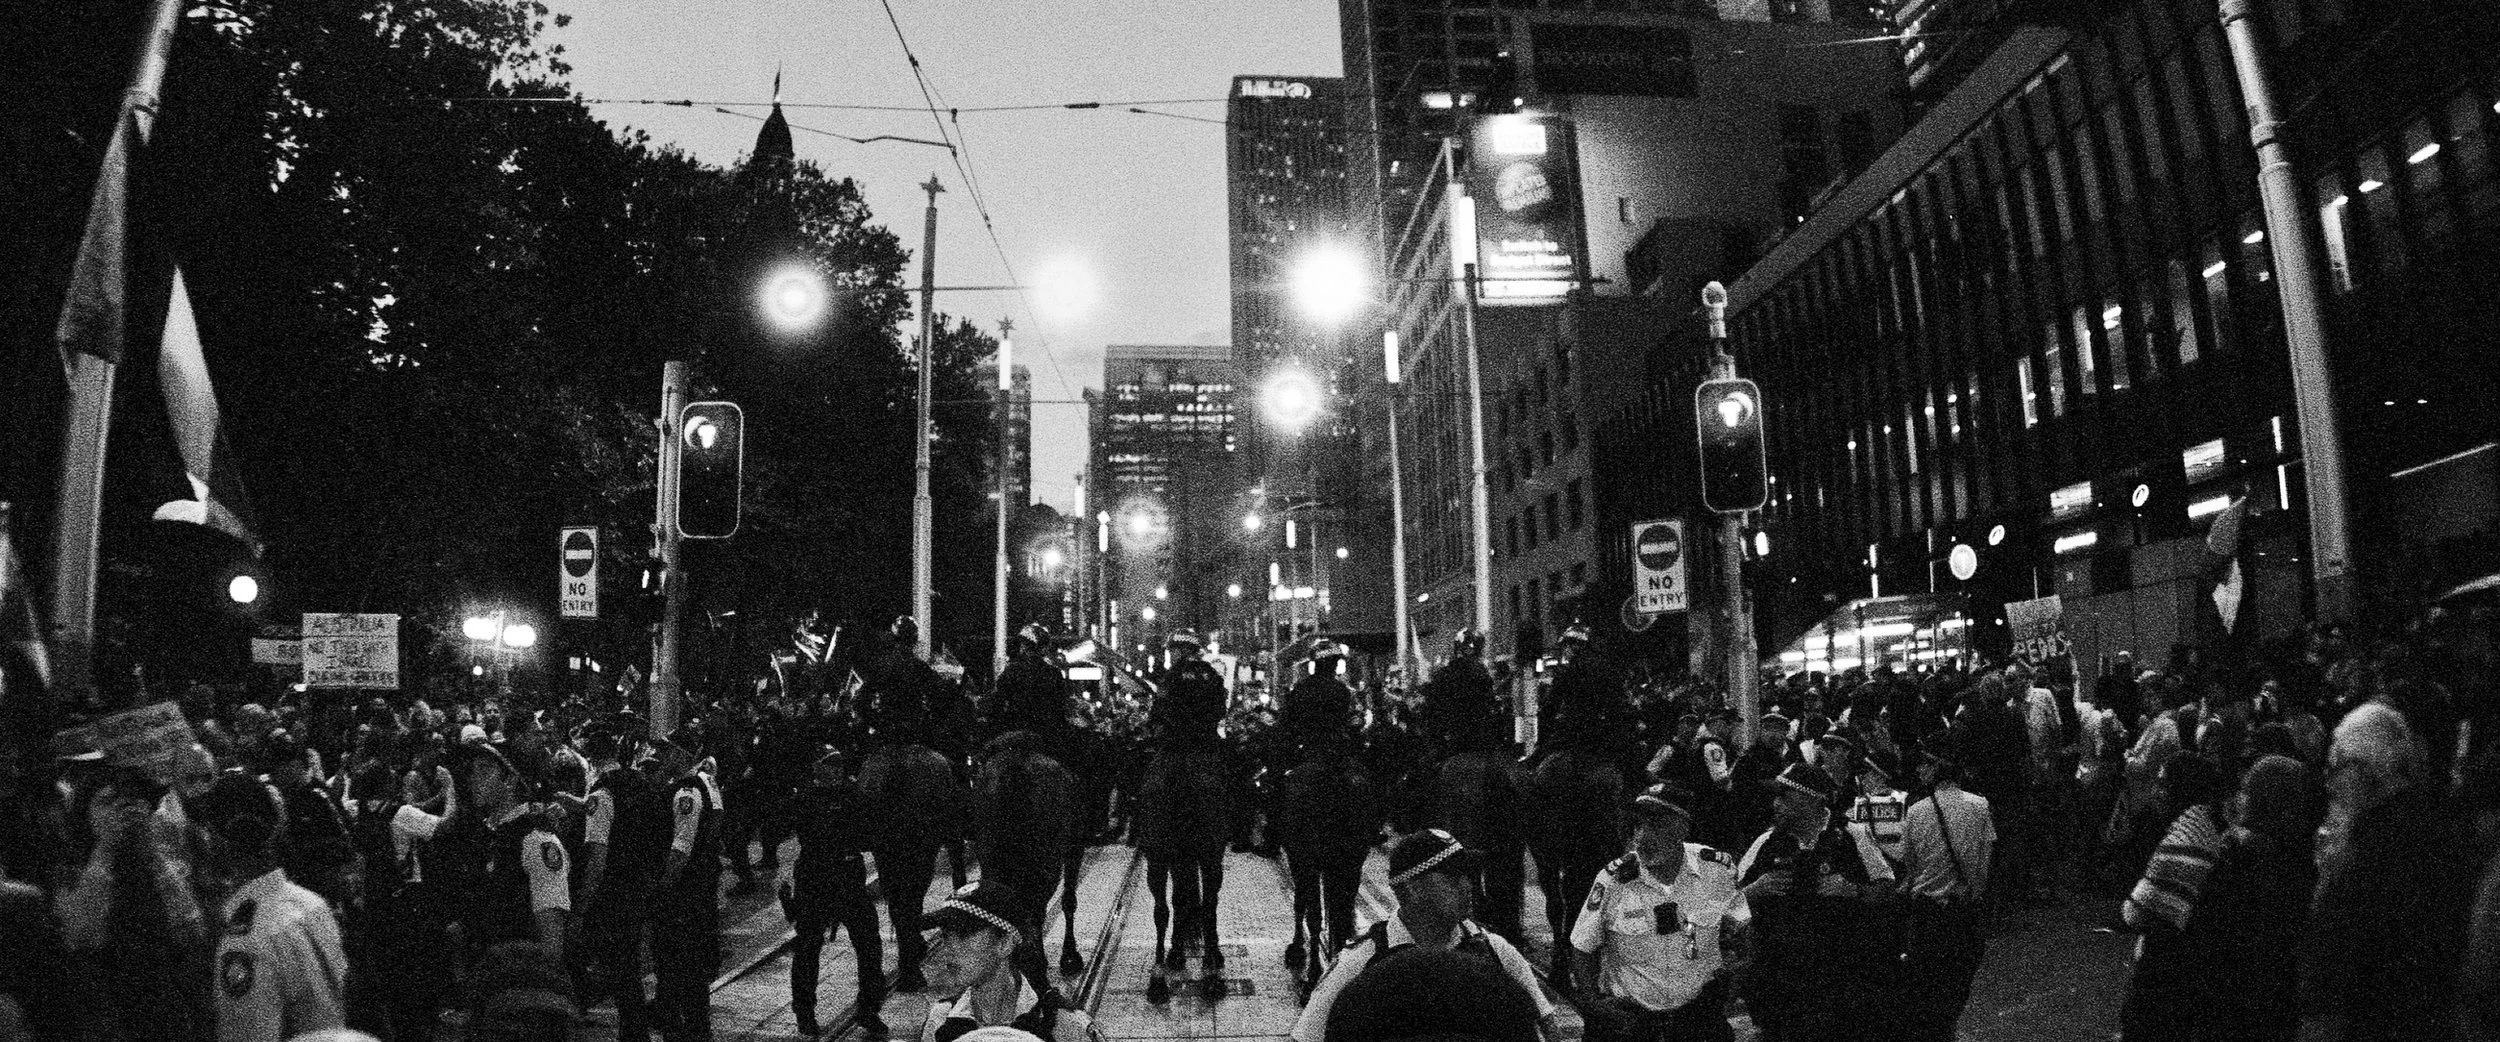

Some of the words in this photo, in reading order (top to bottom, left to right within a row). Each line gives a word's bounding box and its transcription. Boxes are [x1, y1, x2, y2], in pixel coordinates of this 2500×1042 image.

[569, 582, 587, 596] NO
[1649, 575, 1673, 590] NO
[562, 600, 594, 611] ENTRY
[1640, 592, 1684, 607] ENTRY
